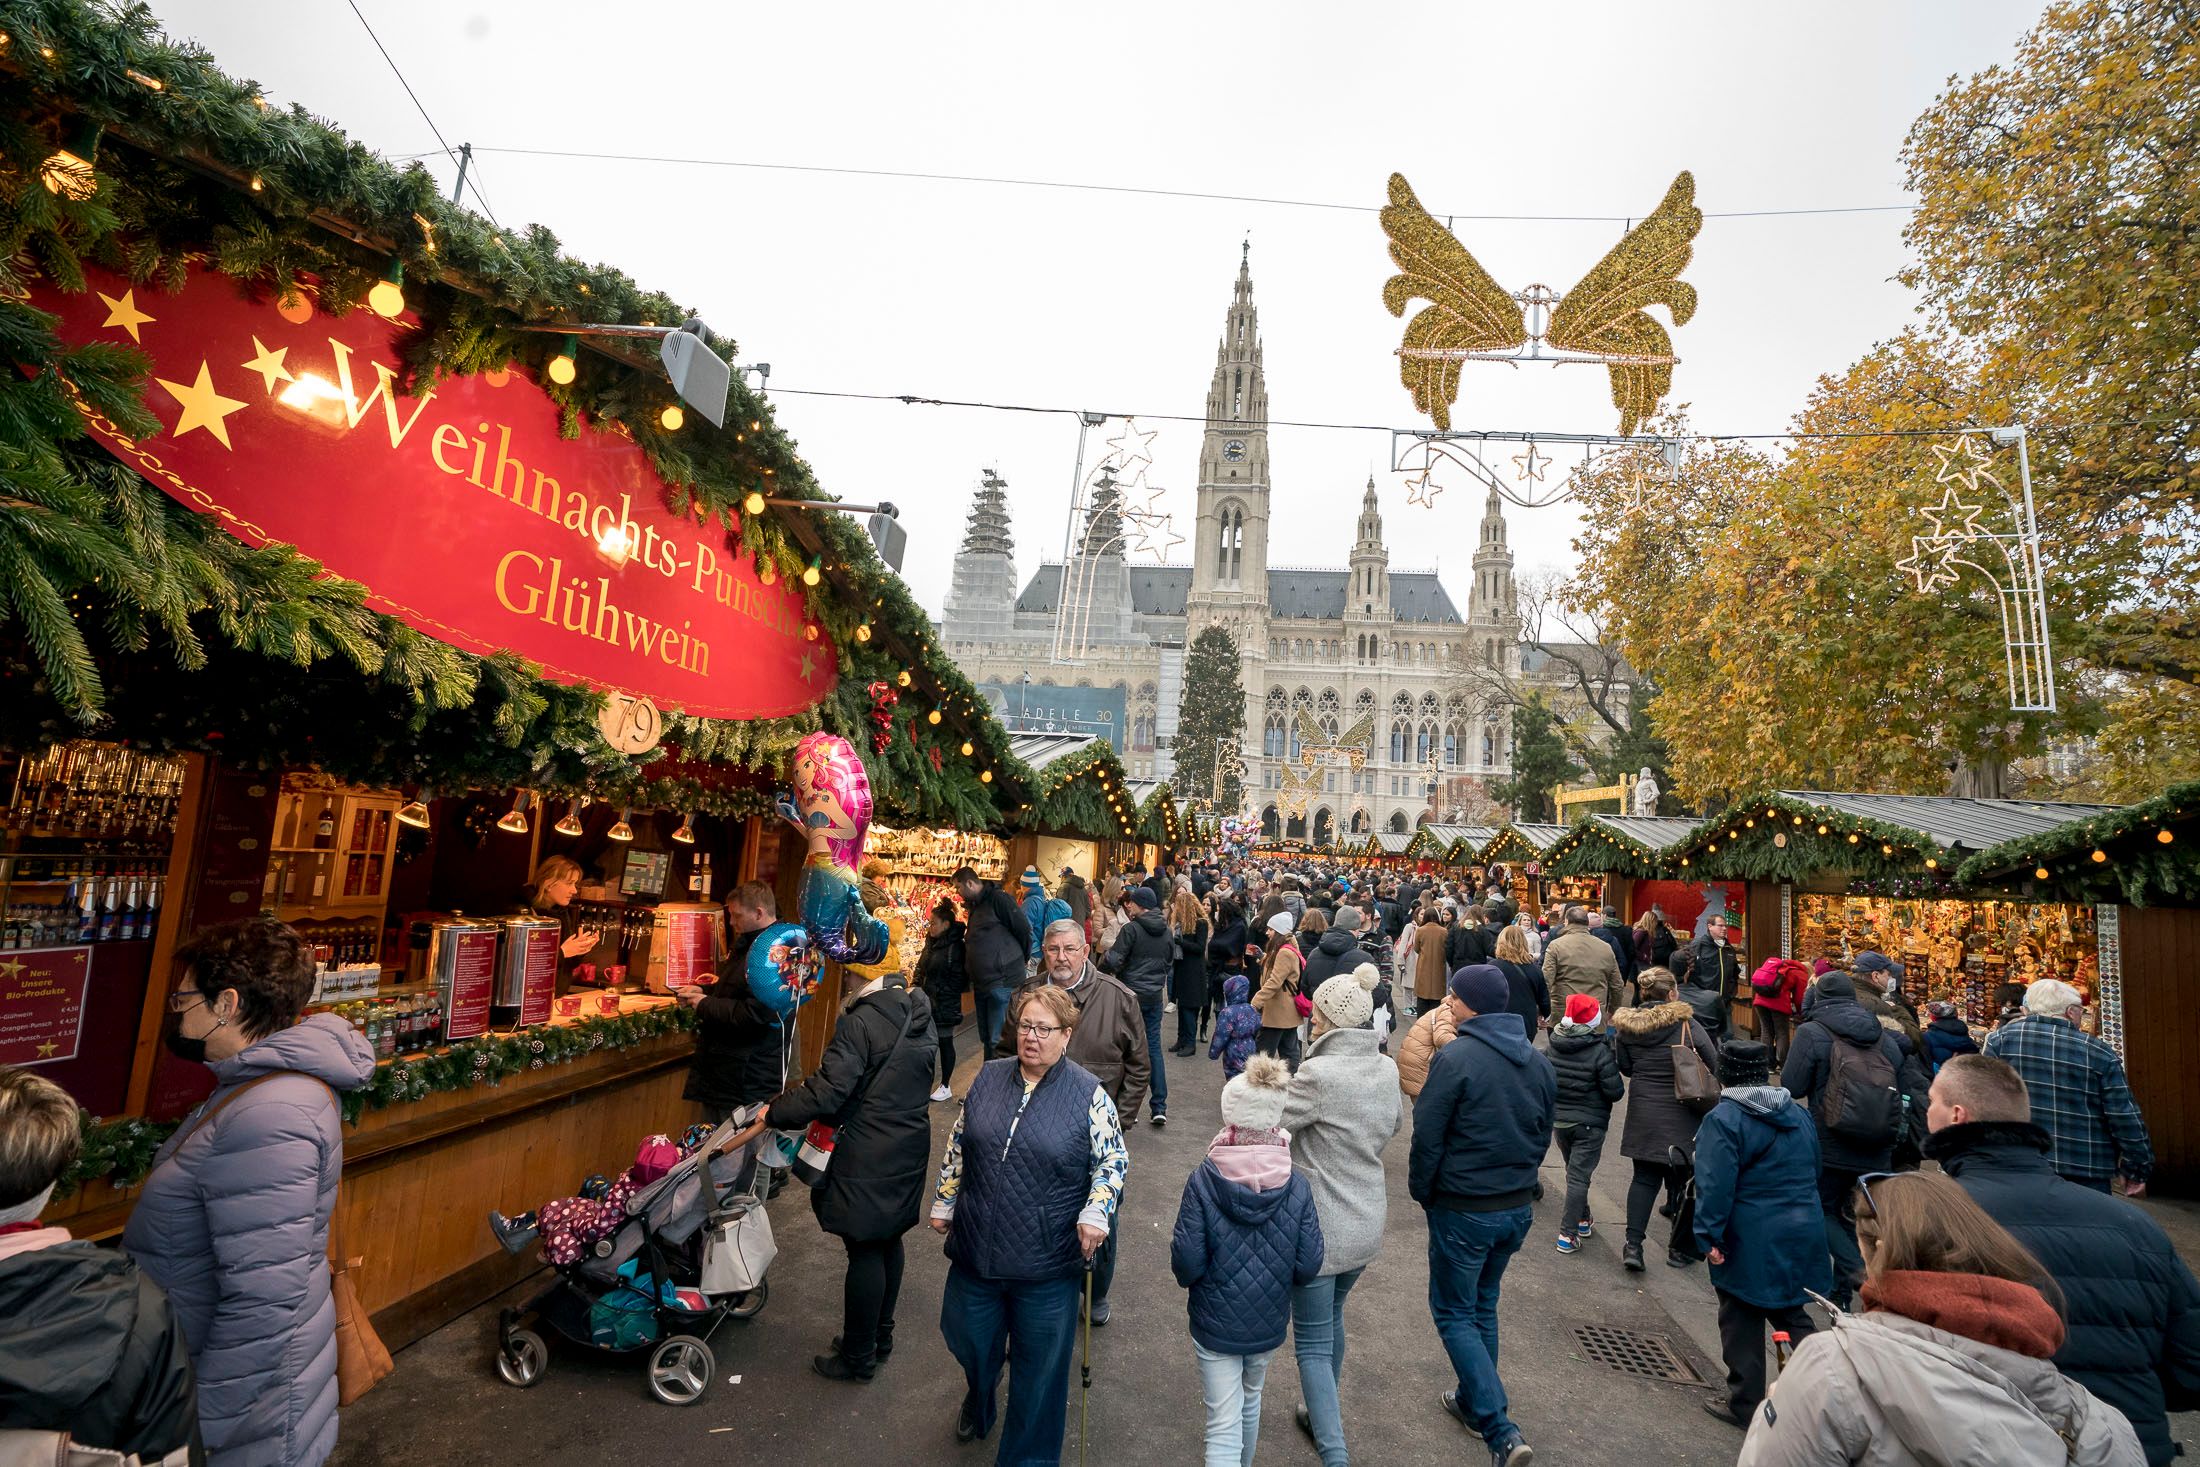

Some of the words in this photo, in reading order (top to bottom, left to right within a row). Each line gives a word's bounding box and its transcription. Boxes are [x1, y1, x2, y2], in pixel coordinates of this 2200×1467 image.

[495, 549, 711, 678] Glühwein
[617, 697, 653, 743] 79
[1023, 707, 1081, 721] ADELE
[1096, 710, 1113, 722] 30
[30, 969, 52, 978] Neu:
[21, 979, 53, 989] Unsere
[6, 987, 66, 1000] Bio-Produkte
